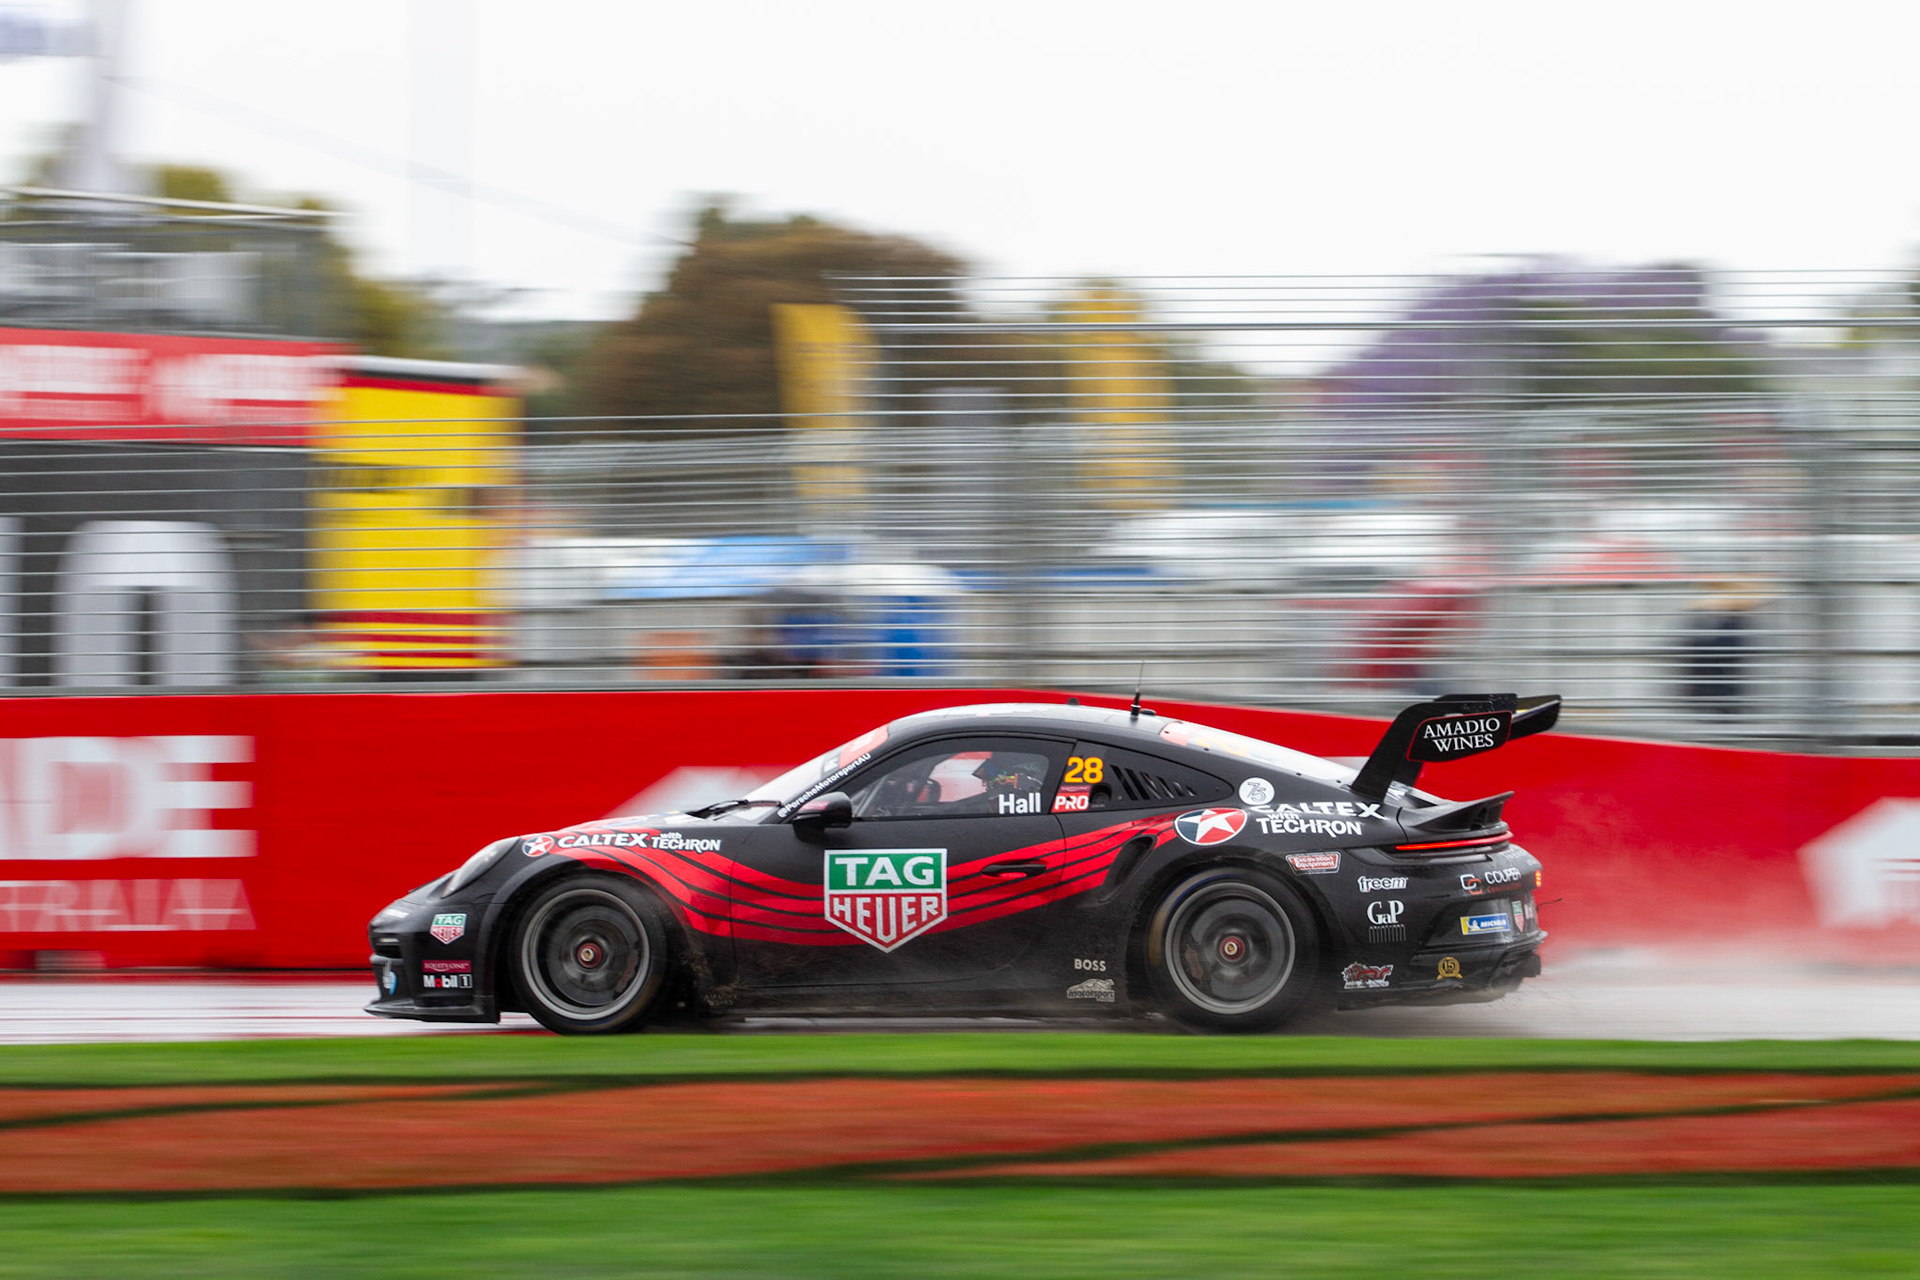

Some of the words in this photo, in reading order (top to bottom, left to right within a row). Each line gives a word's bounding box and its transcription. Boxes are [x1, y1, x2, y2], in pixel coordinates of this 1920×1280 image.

[1423, 717, 1501, 739] AMADIO
[1432, 733, 1495, 753] WINES
[1064, 756, 1104, 784] 28
[998, 792, 1041, 815] Hall
[1053, 795, 1090, 811] PRO
[1250, 801, 1391, 821] CALTEX
[659, 831, 683, 840] with
[1255, 817, 1363, 838] TECHRON
[557, 832, 650, 849] CALTEX
[651, 836, 722, 853] TECHRON
[834, 855, 935, 887] TAG
[1357, 876, 1408, 893] freem
[437, 915, 463, 925] TAG
[832, 896, 939, 943] HEUER
[1073, 958, 1107, 972] BOSS
[423, 974, 459, 988] Mobil
